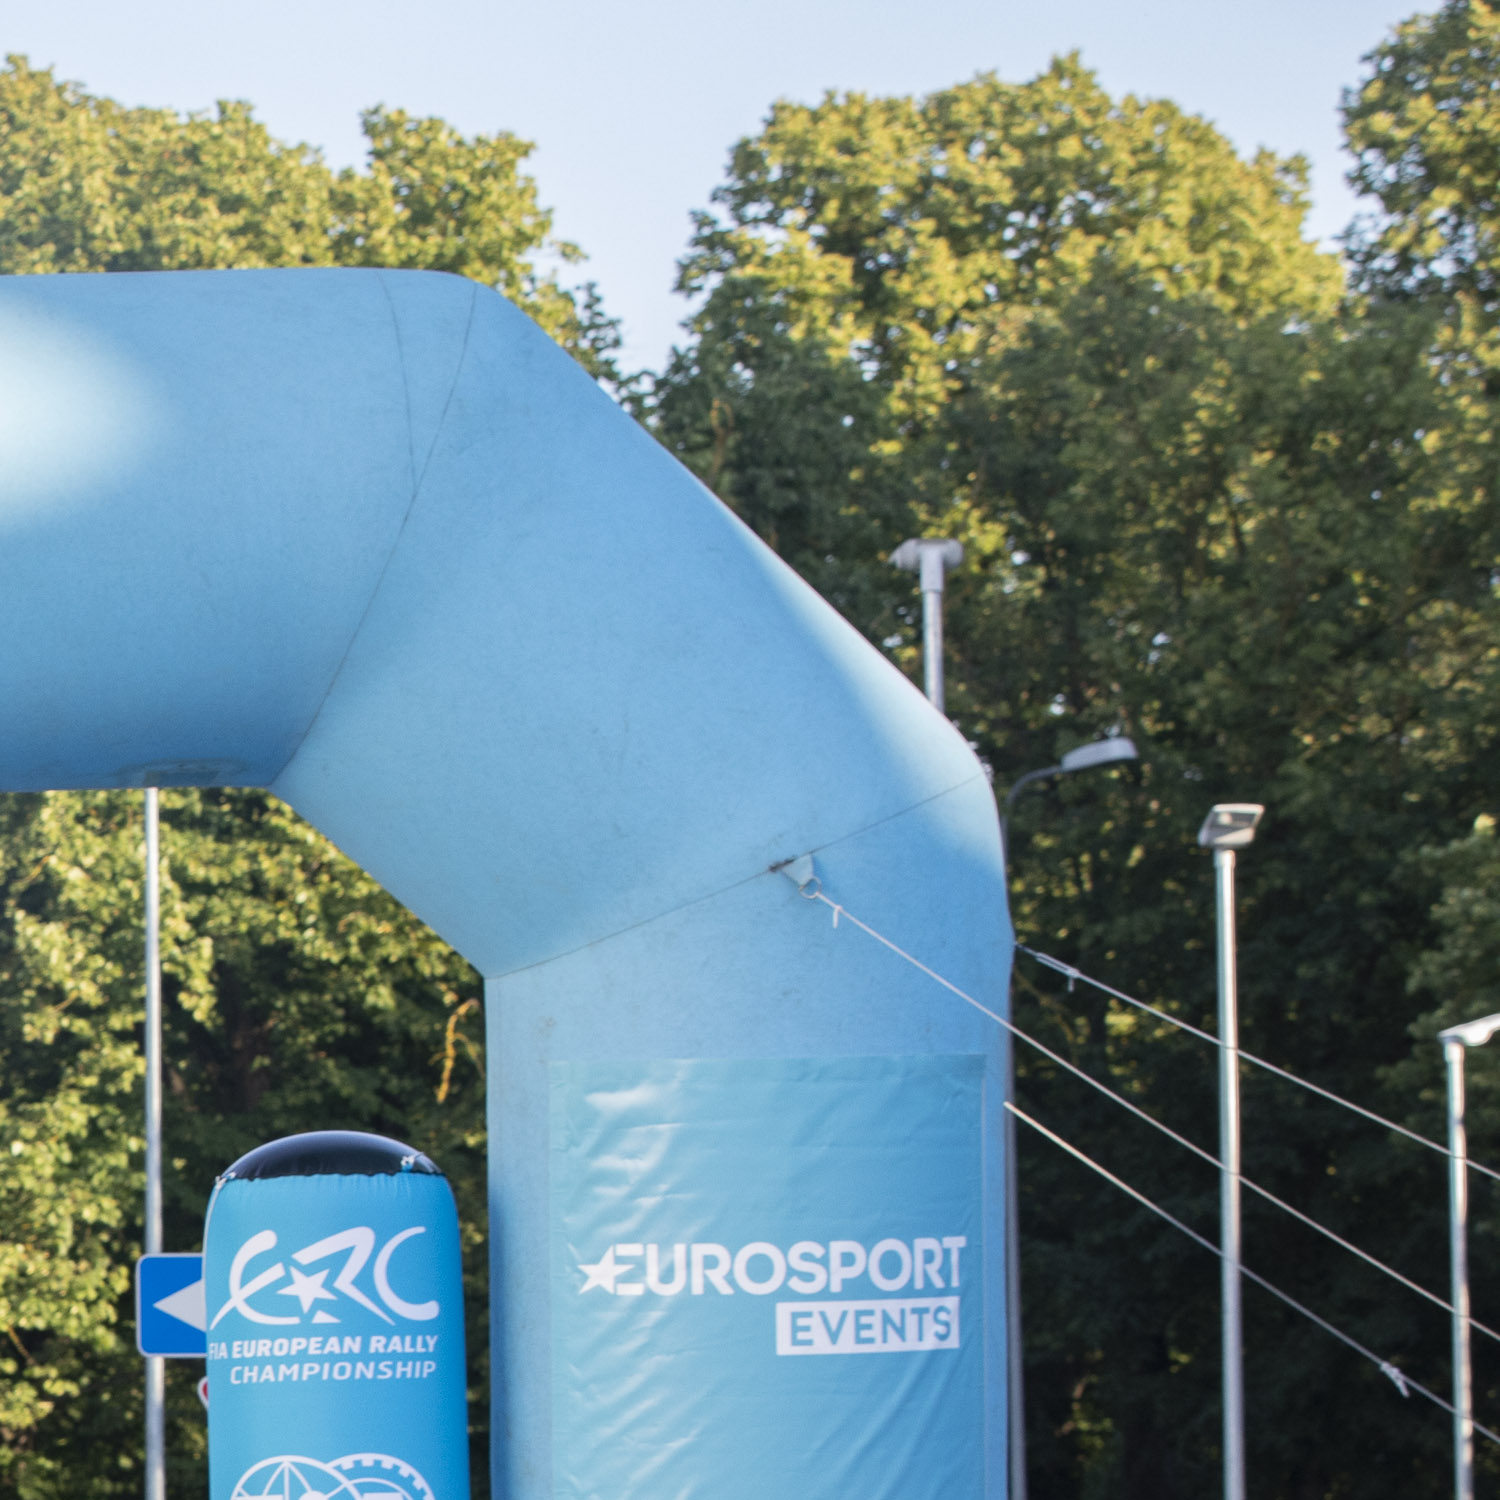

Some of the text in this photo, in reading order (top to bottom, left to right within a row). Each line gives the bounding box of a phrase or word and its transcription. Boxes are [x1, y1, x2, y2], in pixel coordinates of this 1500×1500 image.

[209, 1225, 440, 1328] ERC
[614, 1236, 968, 1297] EUROSPORT
[208, 1334, 440, 1361] FIA EUROPEAN RALLY
[790, 1306, 952, 1348] EVENTS
[229, 1360, 438, 1385] CHAMPIONSHIP
